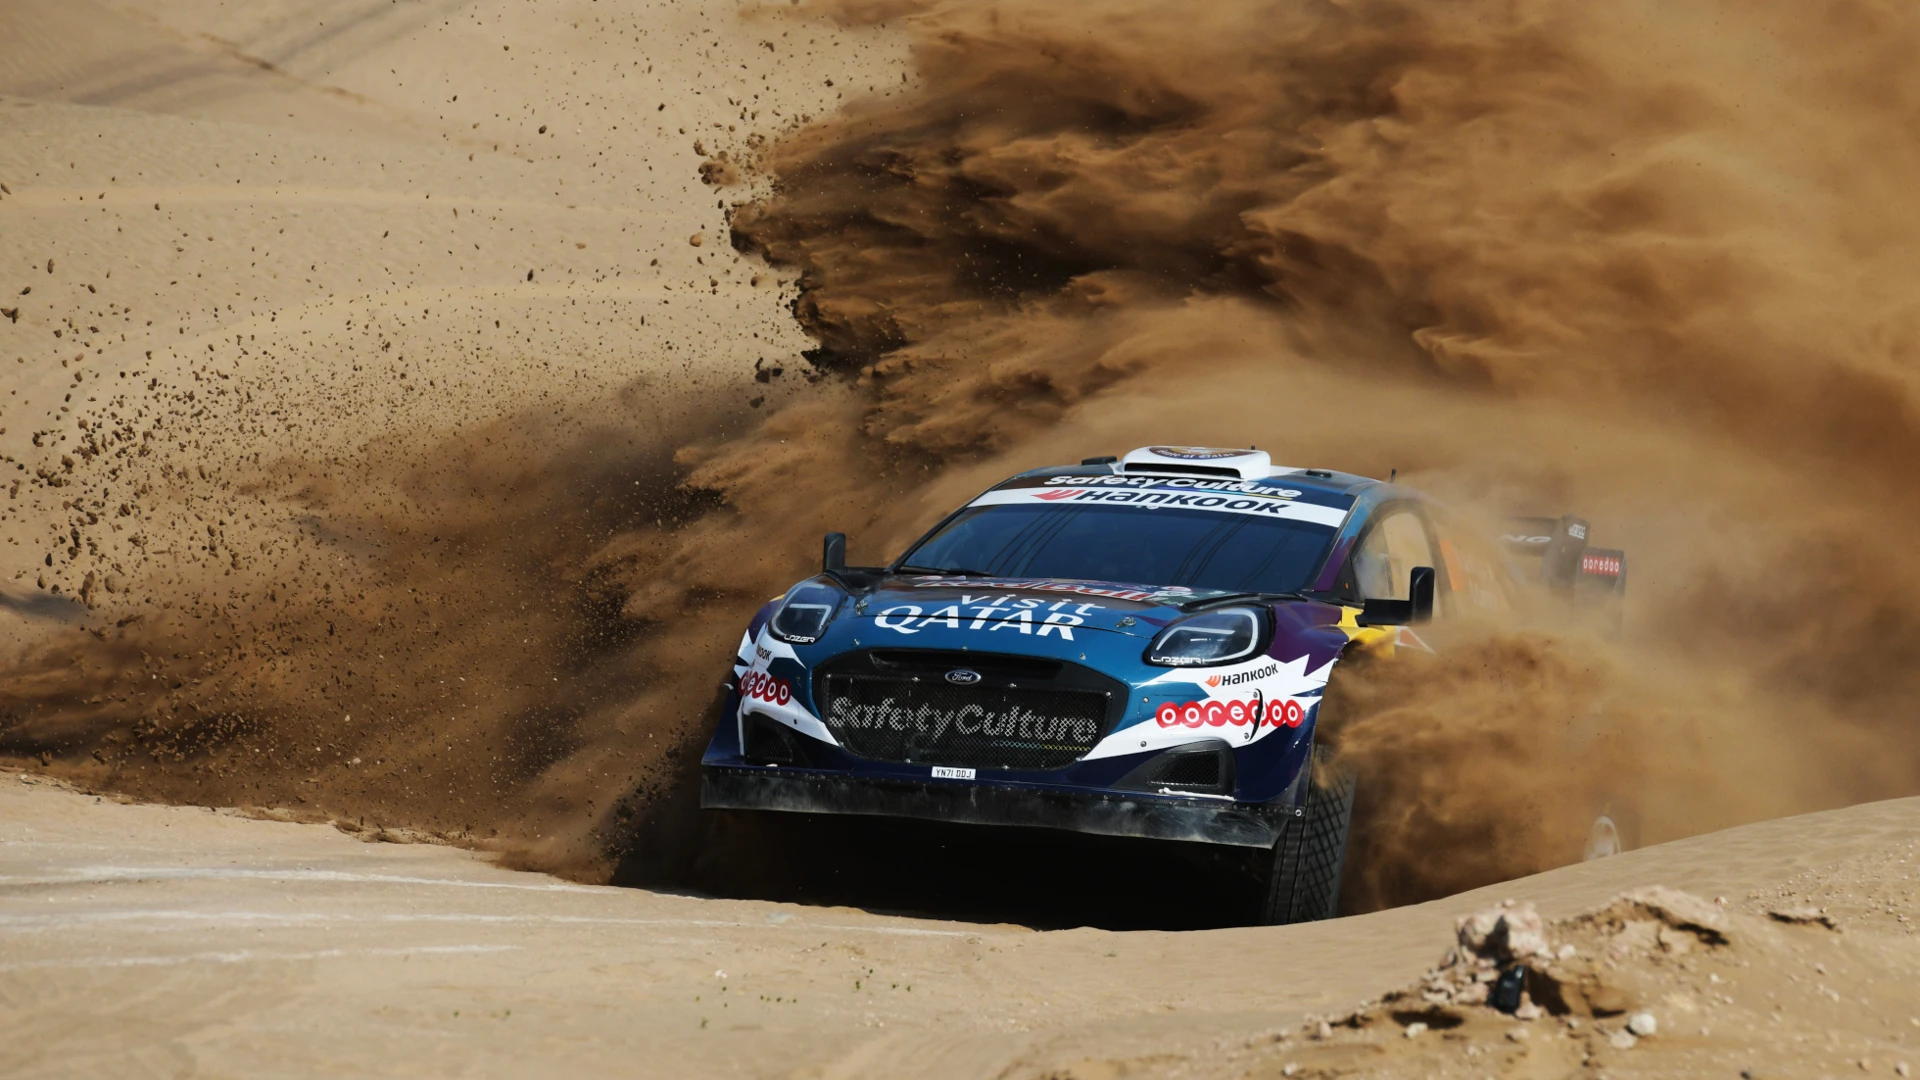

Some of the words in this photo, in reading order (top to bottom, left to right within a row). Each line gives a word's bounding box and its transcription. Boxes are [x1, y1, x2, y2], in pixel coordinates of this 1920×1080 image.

[1044, 475, 1302, 498] SafetyCulture
[1583, 556, 1620, 574] ooredoo
[961, 594, 1105, 616] visit
[873, 605, 1085, 641] QATAR
[952, 672, 973, 682] Ford
[829, 697, 1097, 743] SafetyCulture
[1160, 701, 1300, 725] ooredoo
[935, 768, 954, 778] YN71
